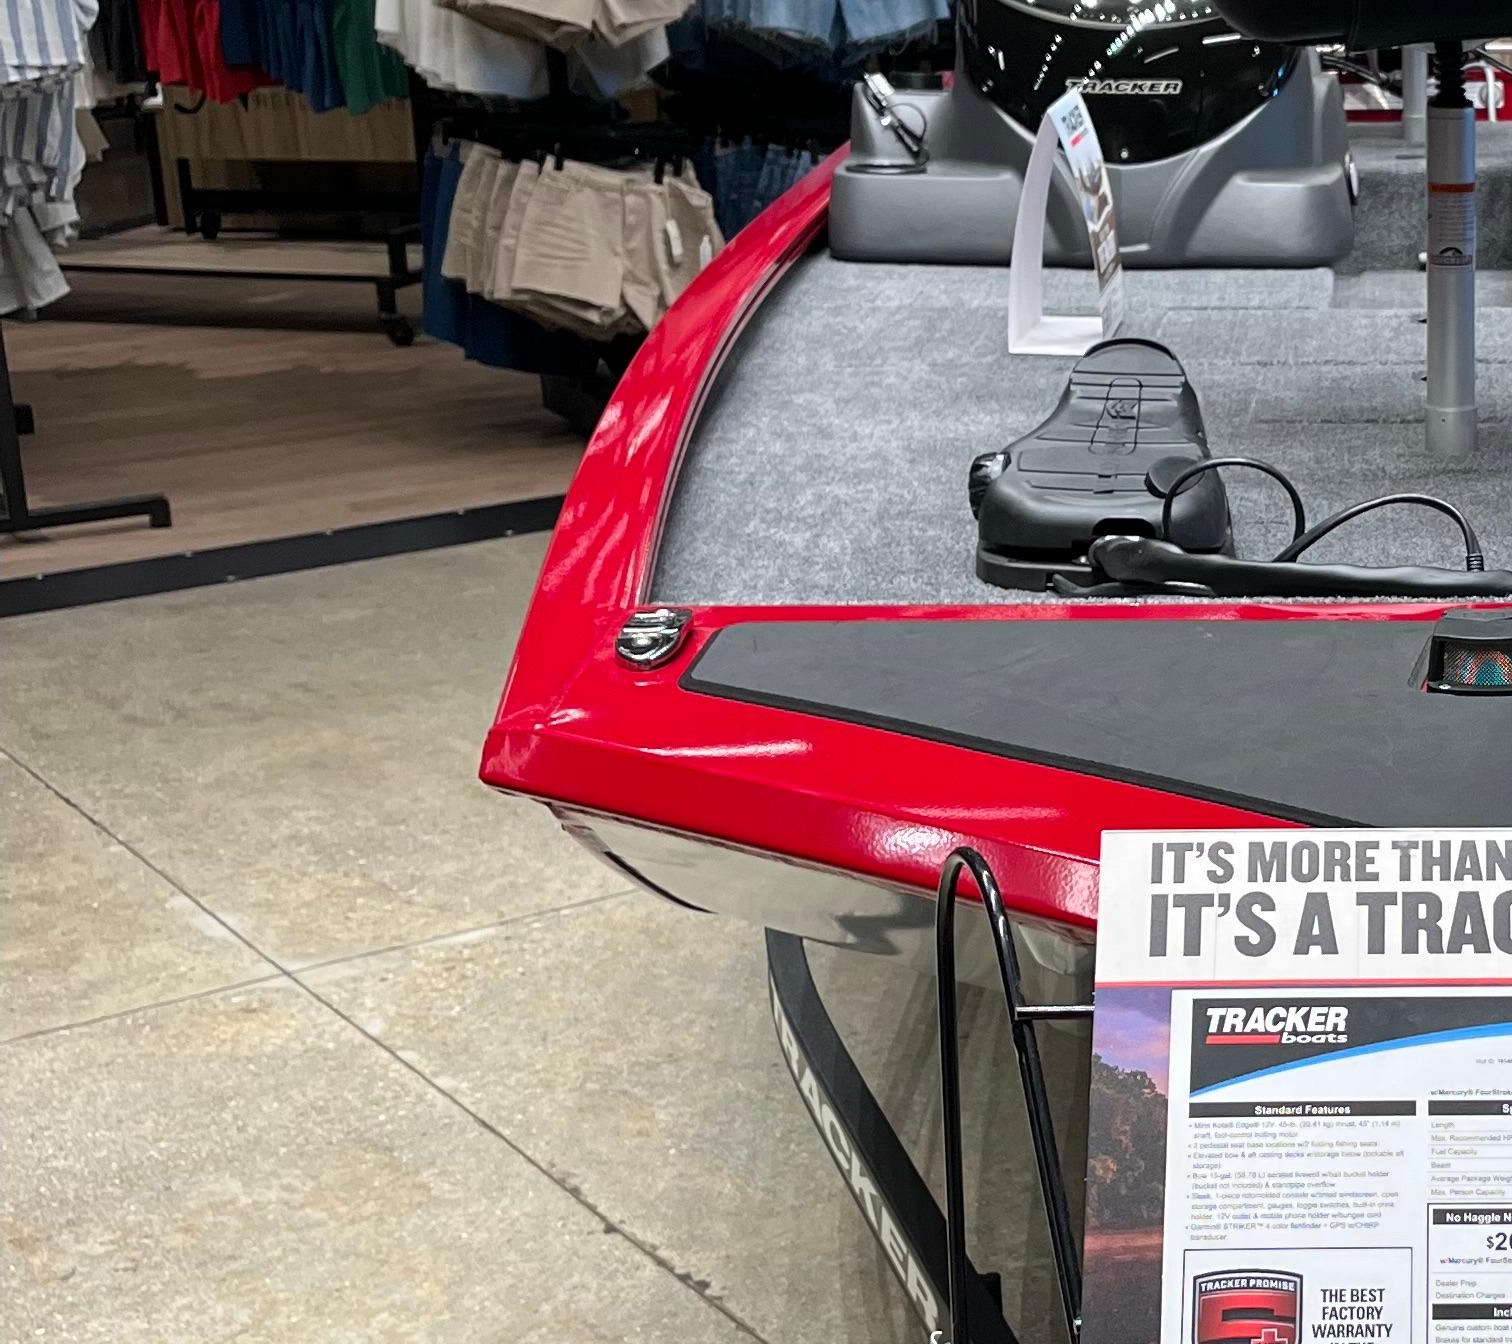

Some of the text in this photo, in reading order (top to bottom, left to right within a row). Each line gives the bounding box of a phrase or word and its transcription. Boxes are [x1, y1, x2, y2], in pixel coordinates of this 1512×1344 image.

[1065, 78, 1183, 95] TRACKER
[1150, 840, 1234, 884] IT'S
[1247, 839, 1380, 883] MORE
[1149, 890, 1276, 957] IT'S
[1293, 891, 1339, 955] A
[1206, 1006, 1349, 1033] TRACKER
[1281, 1032, 1348, 1044] boats
[1254, 1105, 1351, 1115] Standard Features
[1430, 1121, 1455, 1130] Length
[1446, 1213, 1461, 1222] No
[1463, 1212, 1500, 1224] Haggle
[1201, 1278, 1296, 1291] TRACKER PROMISE
[1321, 1288, 1385, 1303] THE BEST
[1322, 1306, 1383, 1320] FACTORY
[1312, 1324, 1393, 1338] WARRANTY
